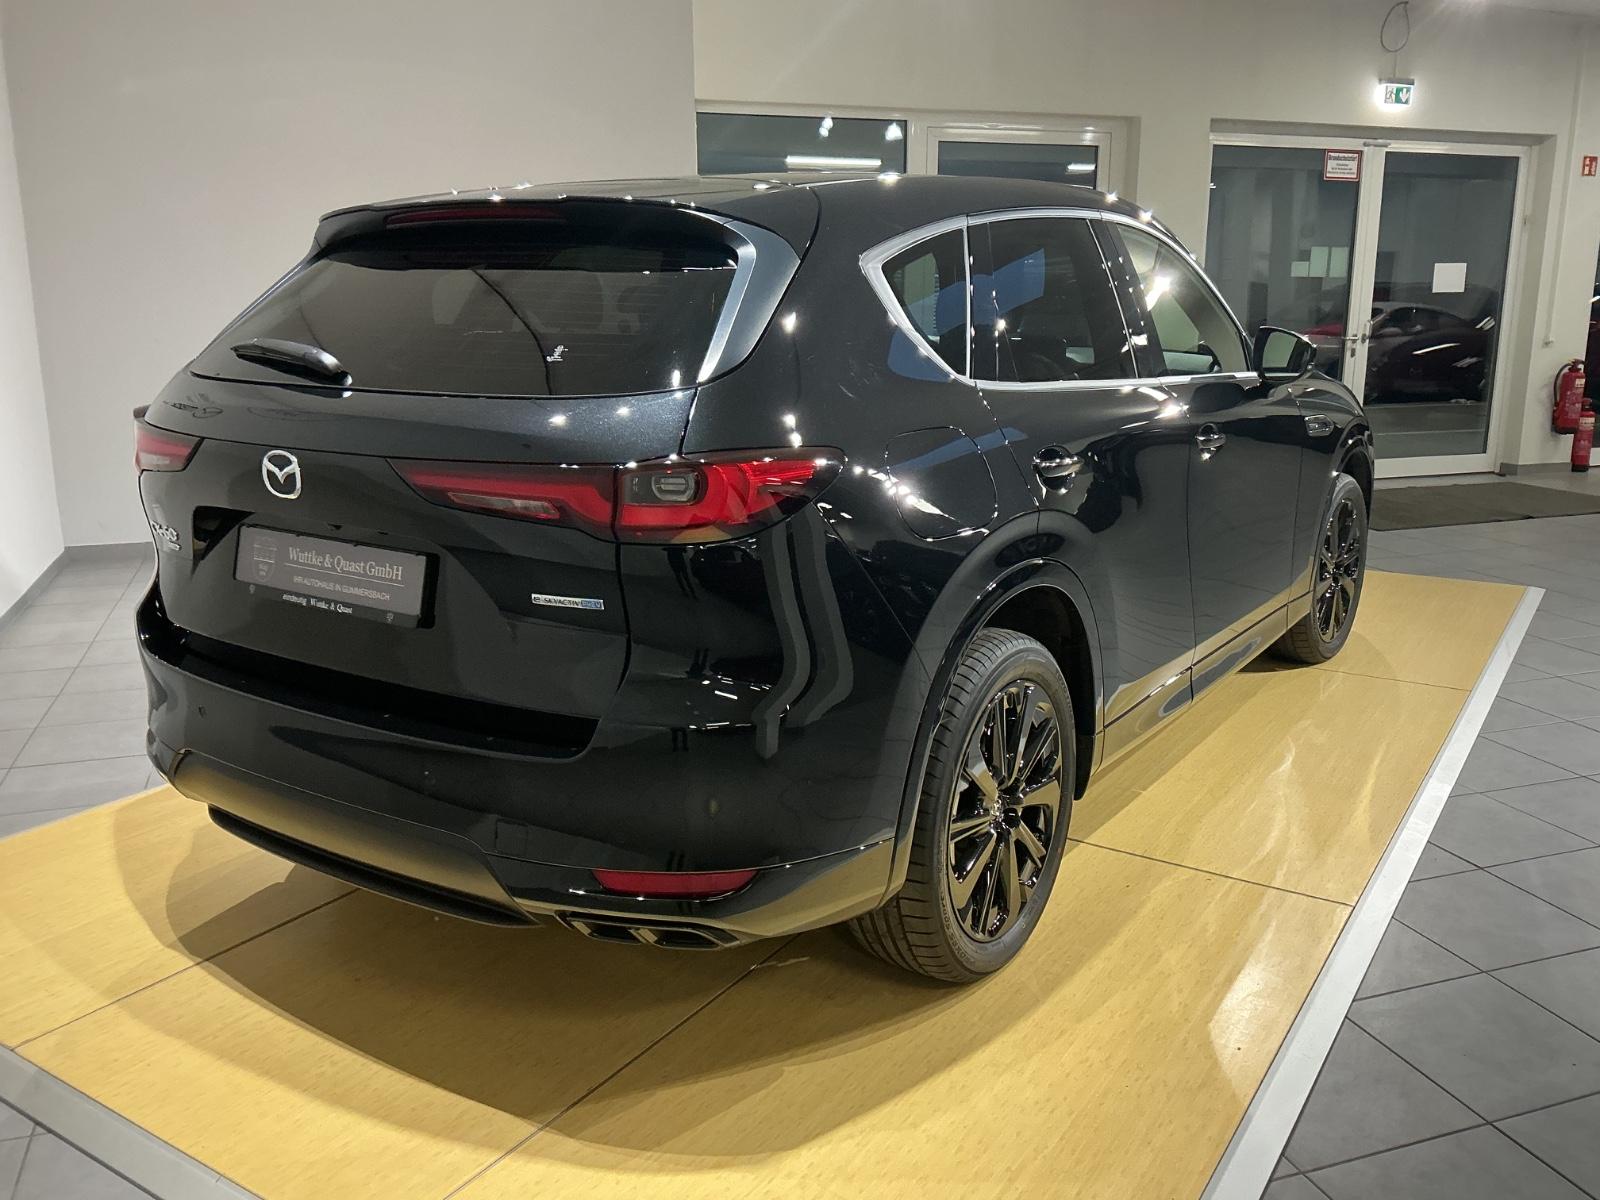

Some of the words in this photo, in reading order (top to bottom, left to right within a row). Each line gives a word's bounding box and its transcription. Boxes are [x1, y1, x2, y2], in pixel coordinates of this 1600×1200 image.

[288, 547, 322, 566] Wuttke
[324, 553, 333, 567] &
[334, 555, 365, 573] Quast
[366, 561, 403, 581] GmbH
[304, 577, 333, 591] AUTOHAUS
[342, 585, 390, 600] GUMMERSBACH
